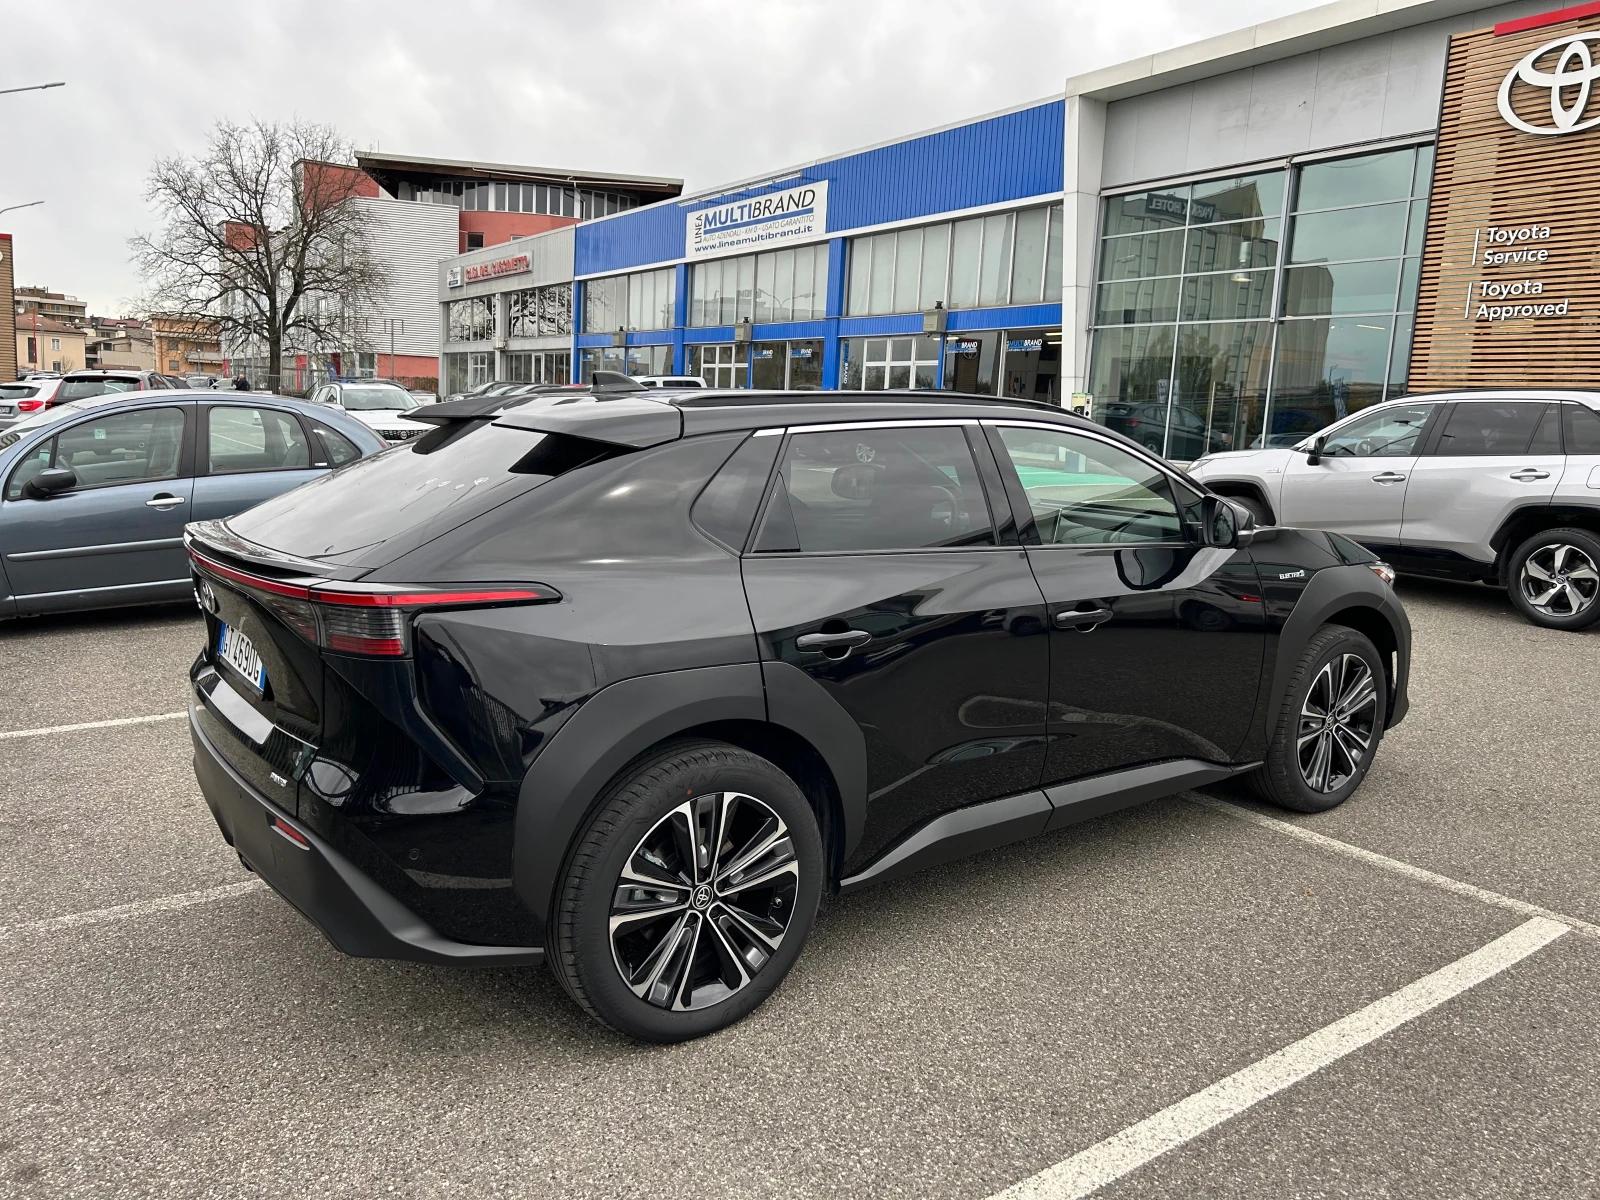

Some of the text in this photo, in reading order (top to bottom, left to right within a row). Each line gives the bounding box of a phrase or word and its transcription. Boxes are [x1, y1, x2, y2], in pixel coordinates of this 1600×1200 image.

[704, 189, 816, 228] MULTIBRAND
[694, 214, 703, 244] LINEA
[694, 225, 812, 252] www.lineamultibrand.it
[703, 234, 716, 242] AUTO
[762, 222, 779, 232] USATO
[780, 215, 814, 228] GARANTITO
[1487, 224, 1551, 246] Toyota
[1483, 247, 1549, 266] Service
[1480, 280, 1544, 300] Toyota
[1476, 299, 1569, 322] Approved
